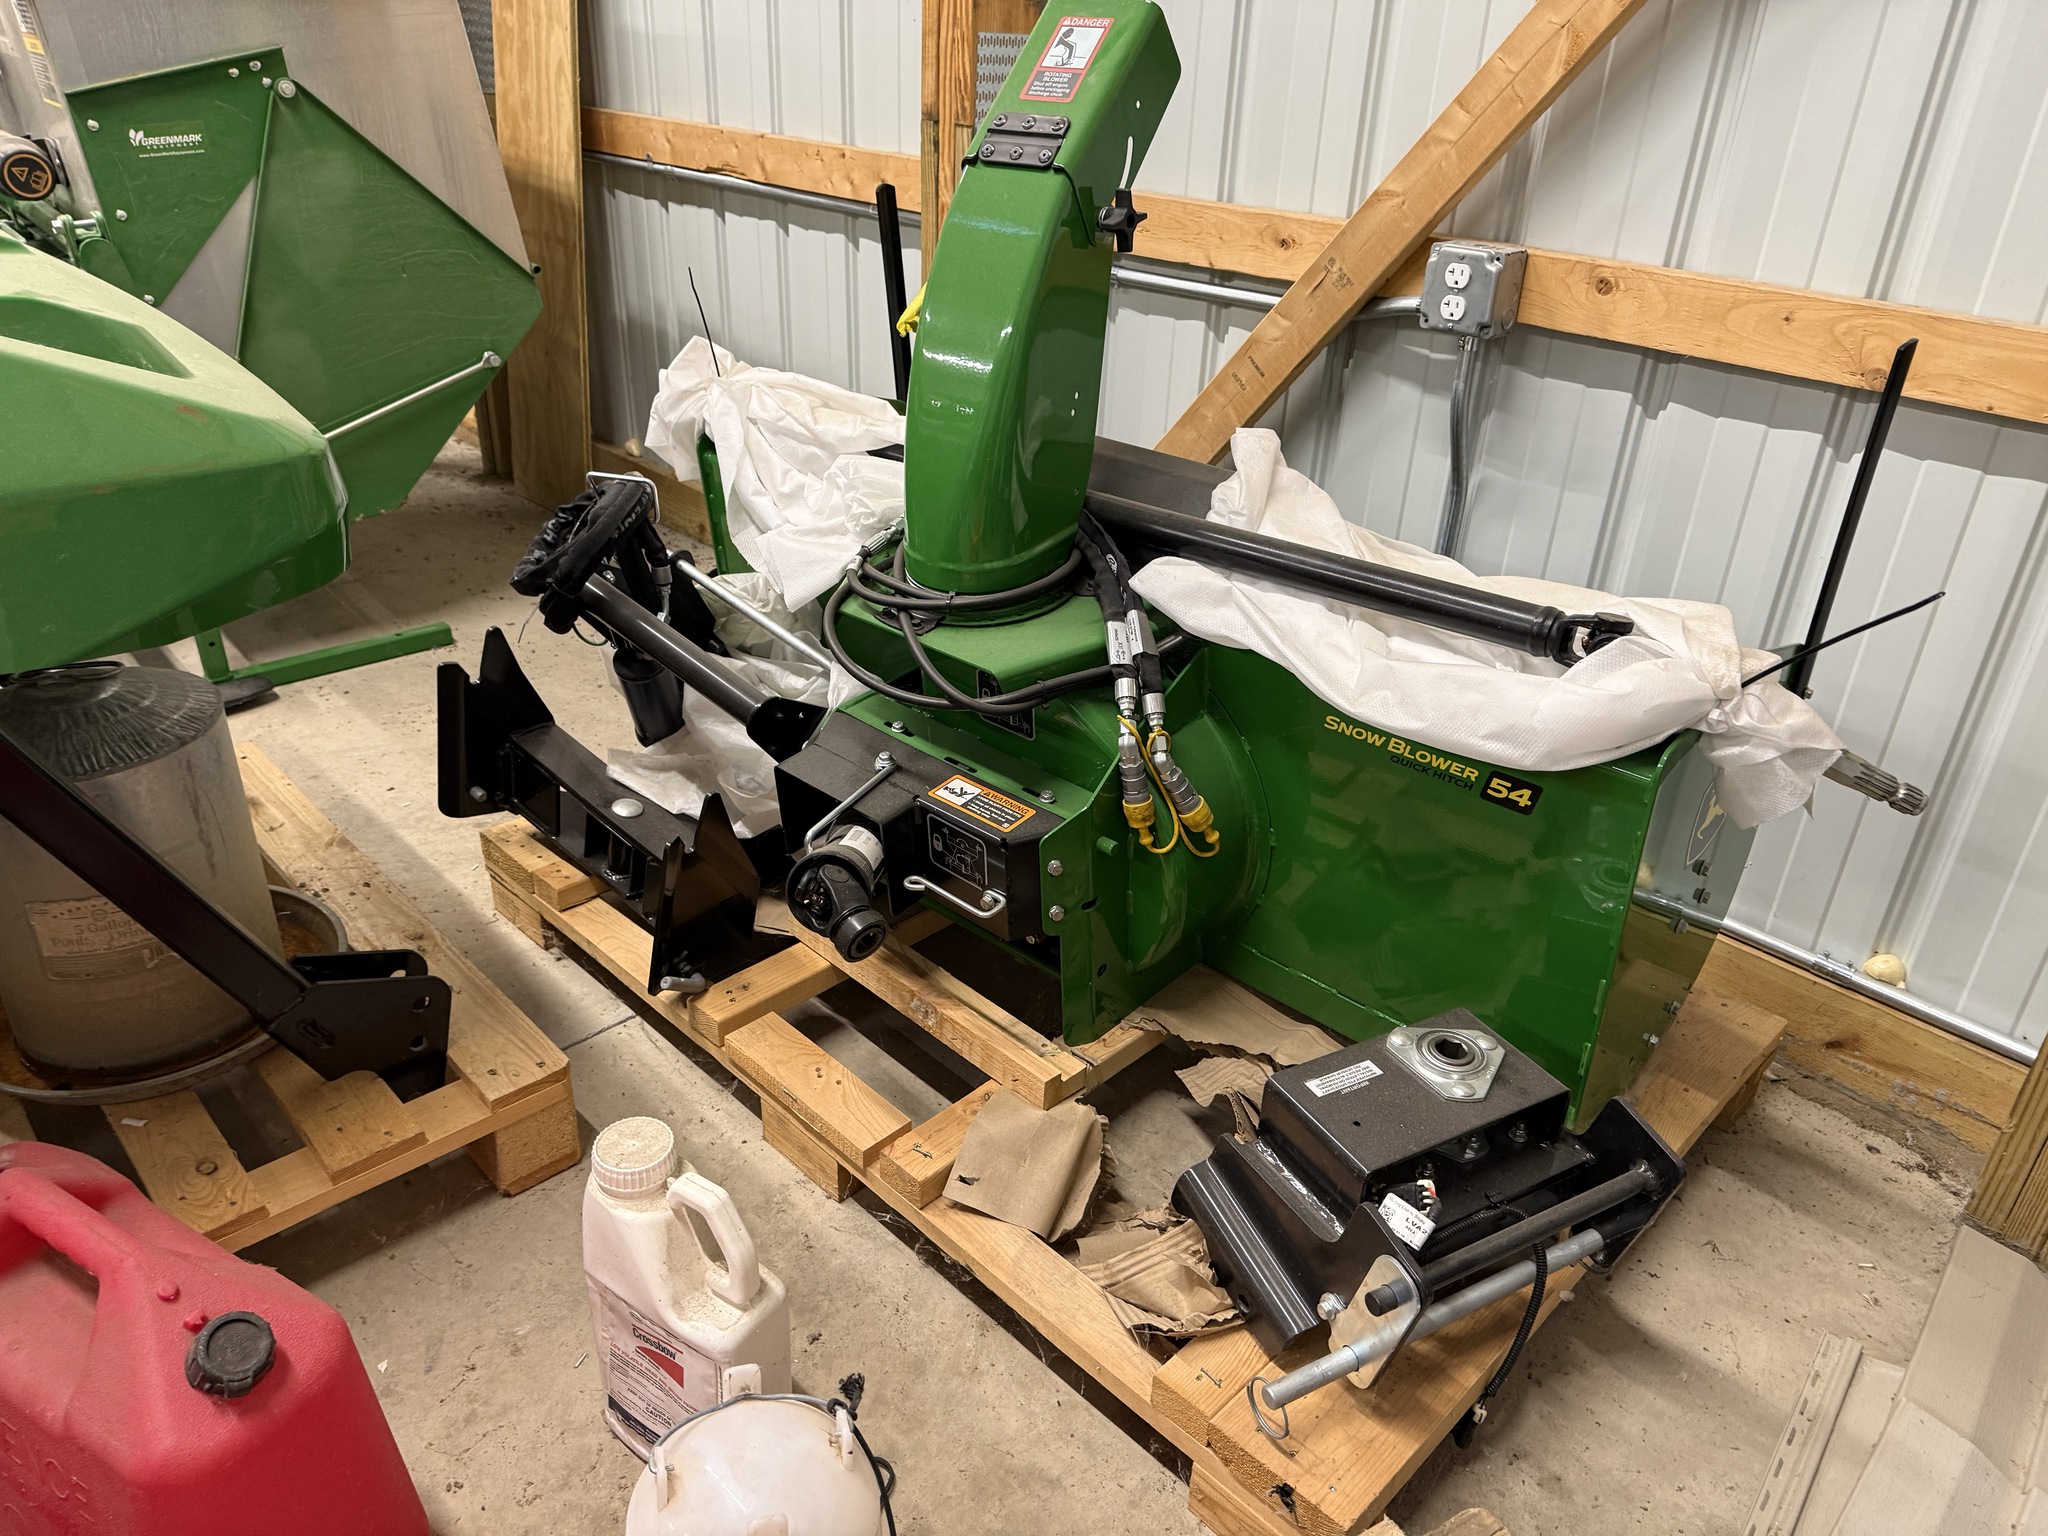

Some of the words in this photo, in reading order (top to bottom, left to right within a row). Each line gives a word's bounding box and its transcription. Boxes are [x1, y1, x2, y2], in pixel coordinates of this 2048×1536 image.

[142, 134, 202, 146] GREENMARK
[1324, 715, 1386, 746] SNOW
[1387, 738, 1479, 781] BLOWER
[1390, 755, 1430, 776] QUICK
[1432, 769, 1474, 791] HITCH
[1486, 777, 1532, 807] 54
[991, 794, 1029, 814] WARNING
[74, 925, 84, 935] 5
[1340, 1081, 1370, 1094] IMPORTANT
[633, 1327, 676, 1360] Crossbow
[646, 1406, 672, 1426] CAUTION
